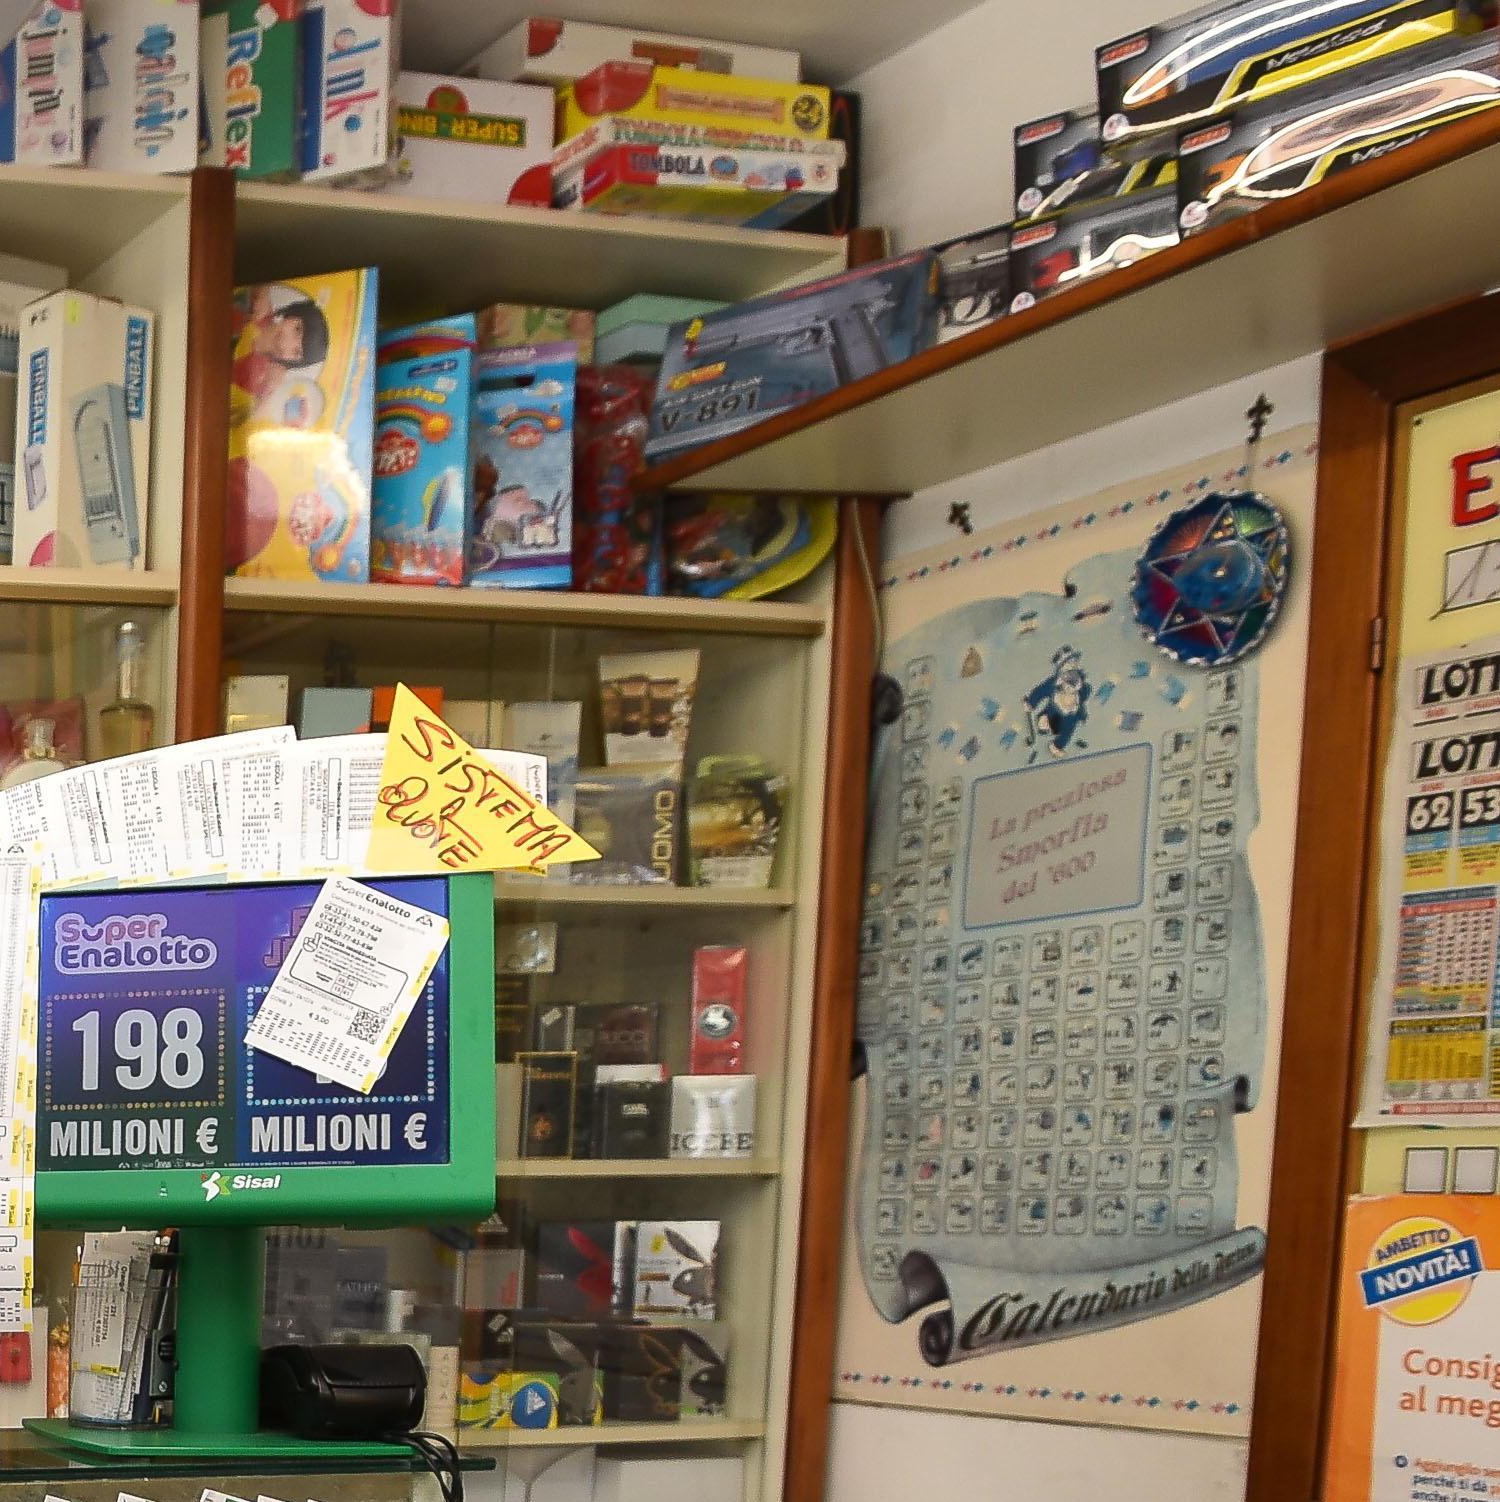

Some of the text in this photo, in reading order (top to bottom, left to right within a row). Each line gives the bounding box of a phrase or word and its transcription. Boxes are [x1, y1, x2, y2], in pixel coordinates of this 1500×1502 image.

[225, 28, 263, 168] Reflex
[29, 348, 49, 446] PINBALL
[1408, 792, 1453, 833] 62
[334, 880, 412, 919] SuperEnalotto
[59, 938, 212, 969] Enalotto
[72, 1006, 204, 1092] 198
[49, 1116, 219, 1157] MILIONI €
[250, 1111, 428, 1153] MILIONI €
[231, 1173, 282, 1191] Sisal
[1375, 1227, 1452, 1262] AMBETTO
[1376, 1248, 1472, 1296] NOVITÀ!
[1399, 1384, 1428, 1412] al
